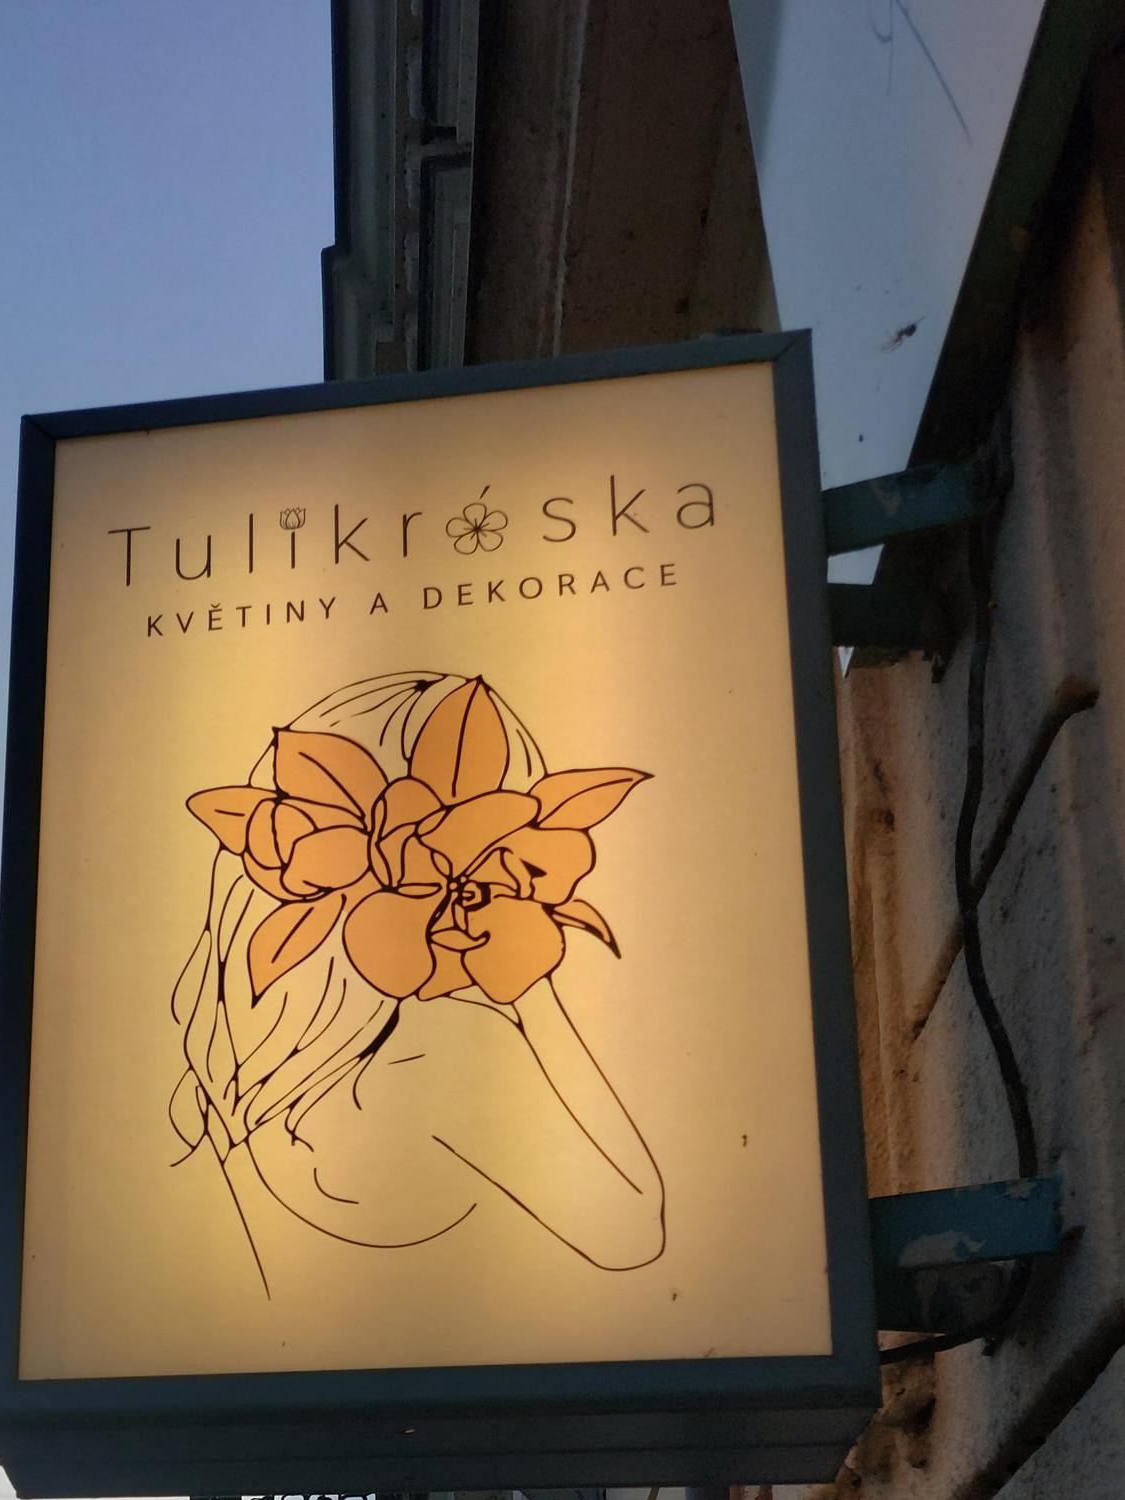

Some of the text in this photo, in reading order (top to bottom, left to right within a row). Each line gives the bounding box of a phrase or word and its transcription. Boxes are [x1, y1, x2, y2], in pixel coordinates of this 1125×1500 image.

[147, 562, 678, 637] KVĚTINY A DEKORACE
